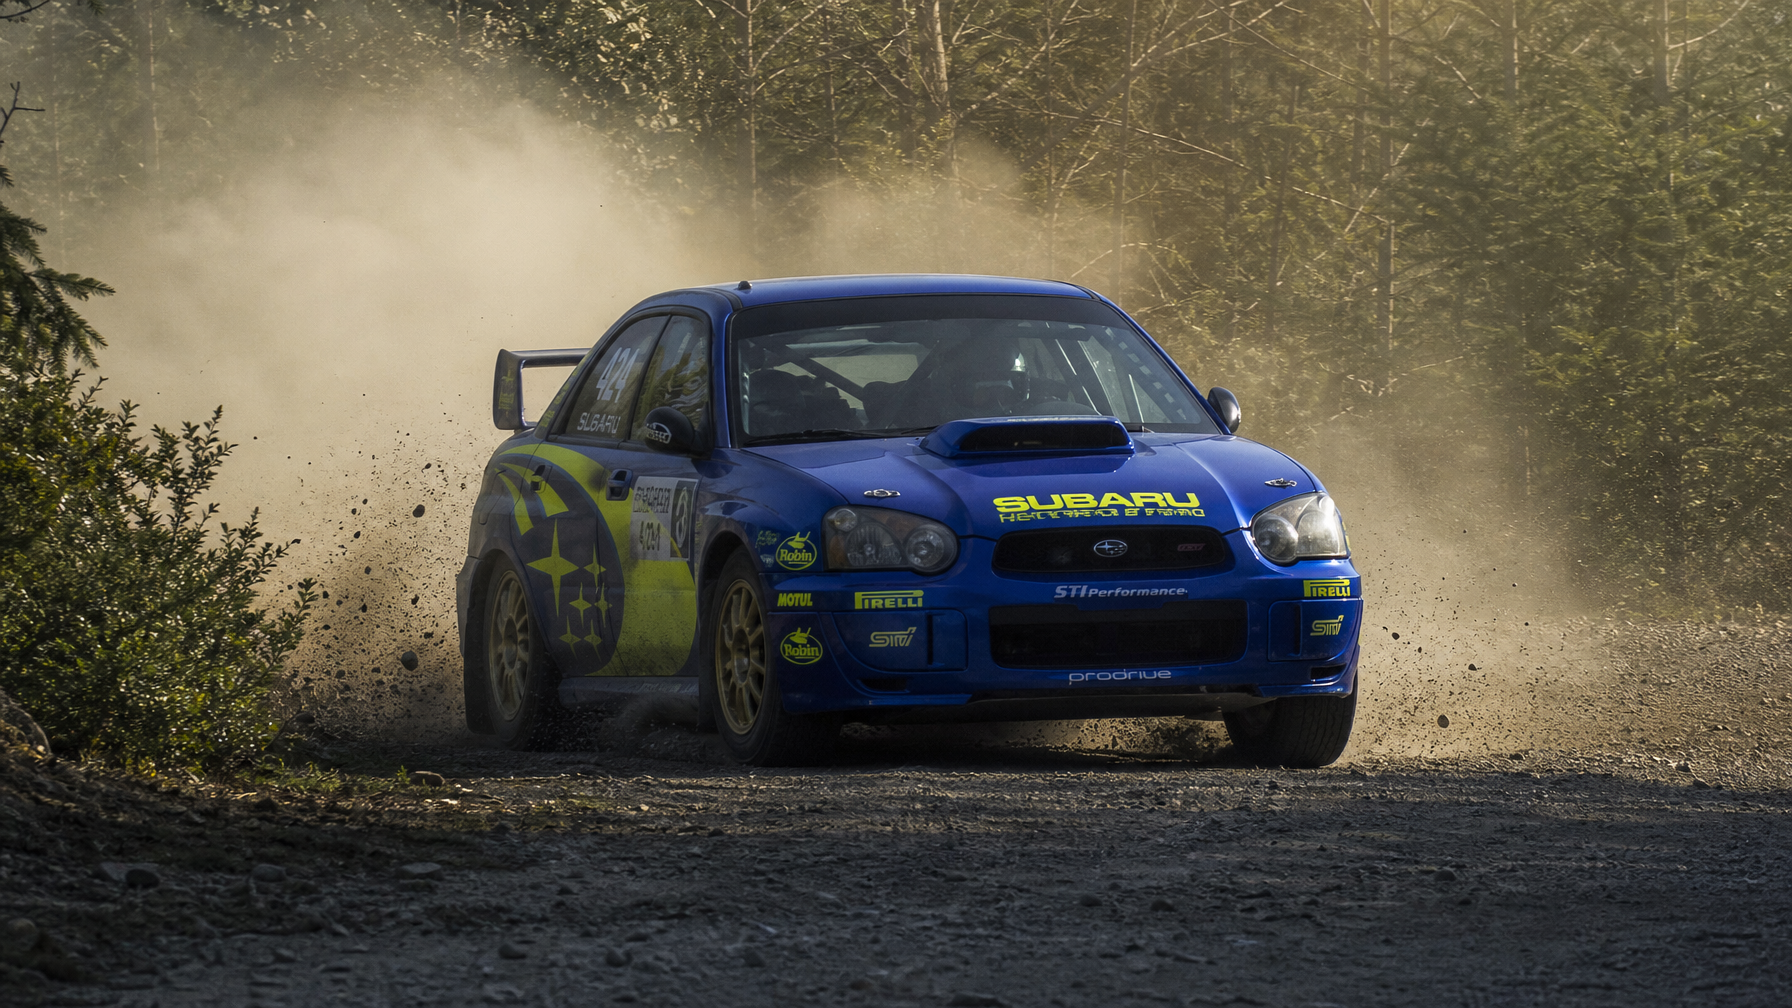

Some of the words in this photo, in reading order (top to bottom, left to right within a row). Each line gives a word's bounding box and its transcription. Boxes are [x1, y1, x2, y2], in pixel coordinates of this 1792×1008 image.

[596, 347, 640, 403] 424
[993, 492, 1202, 513] SUBARU
[780, 548, 812, 562] Robin
[1054, 585, 1088, 598] STI
[1088, 586, 1187, 598] Performance
[1303, 579, 1351, 597] PIRELLI
[777, 592, 813, 607] MOTUL
[855, 590, 924, 609] PIRELLI
[784, 643, 820, 657] Robin
